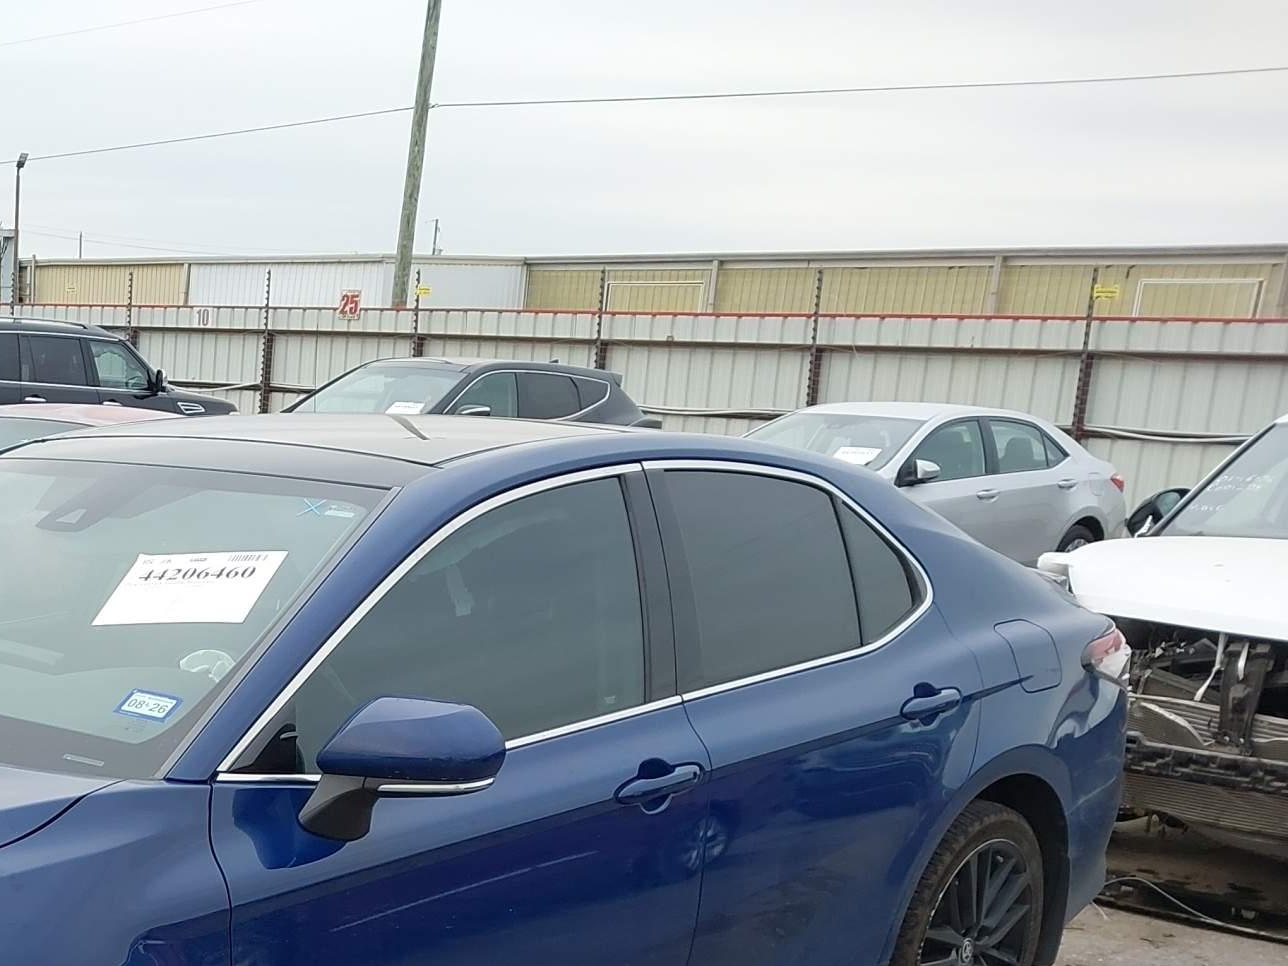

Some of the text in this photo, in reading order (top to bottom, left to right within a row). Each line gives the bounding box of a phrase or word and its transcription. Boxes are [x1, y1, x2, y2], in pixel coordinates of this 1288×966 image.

[339, 294, 360, 315] 25
[196, 308, 210, 326] 10
[138, 566, 257, 581] 44206460
[148, 702, 169, 714] 26
